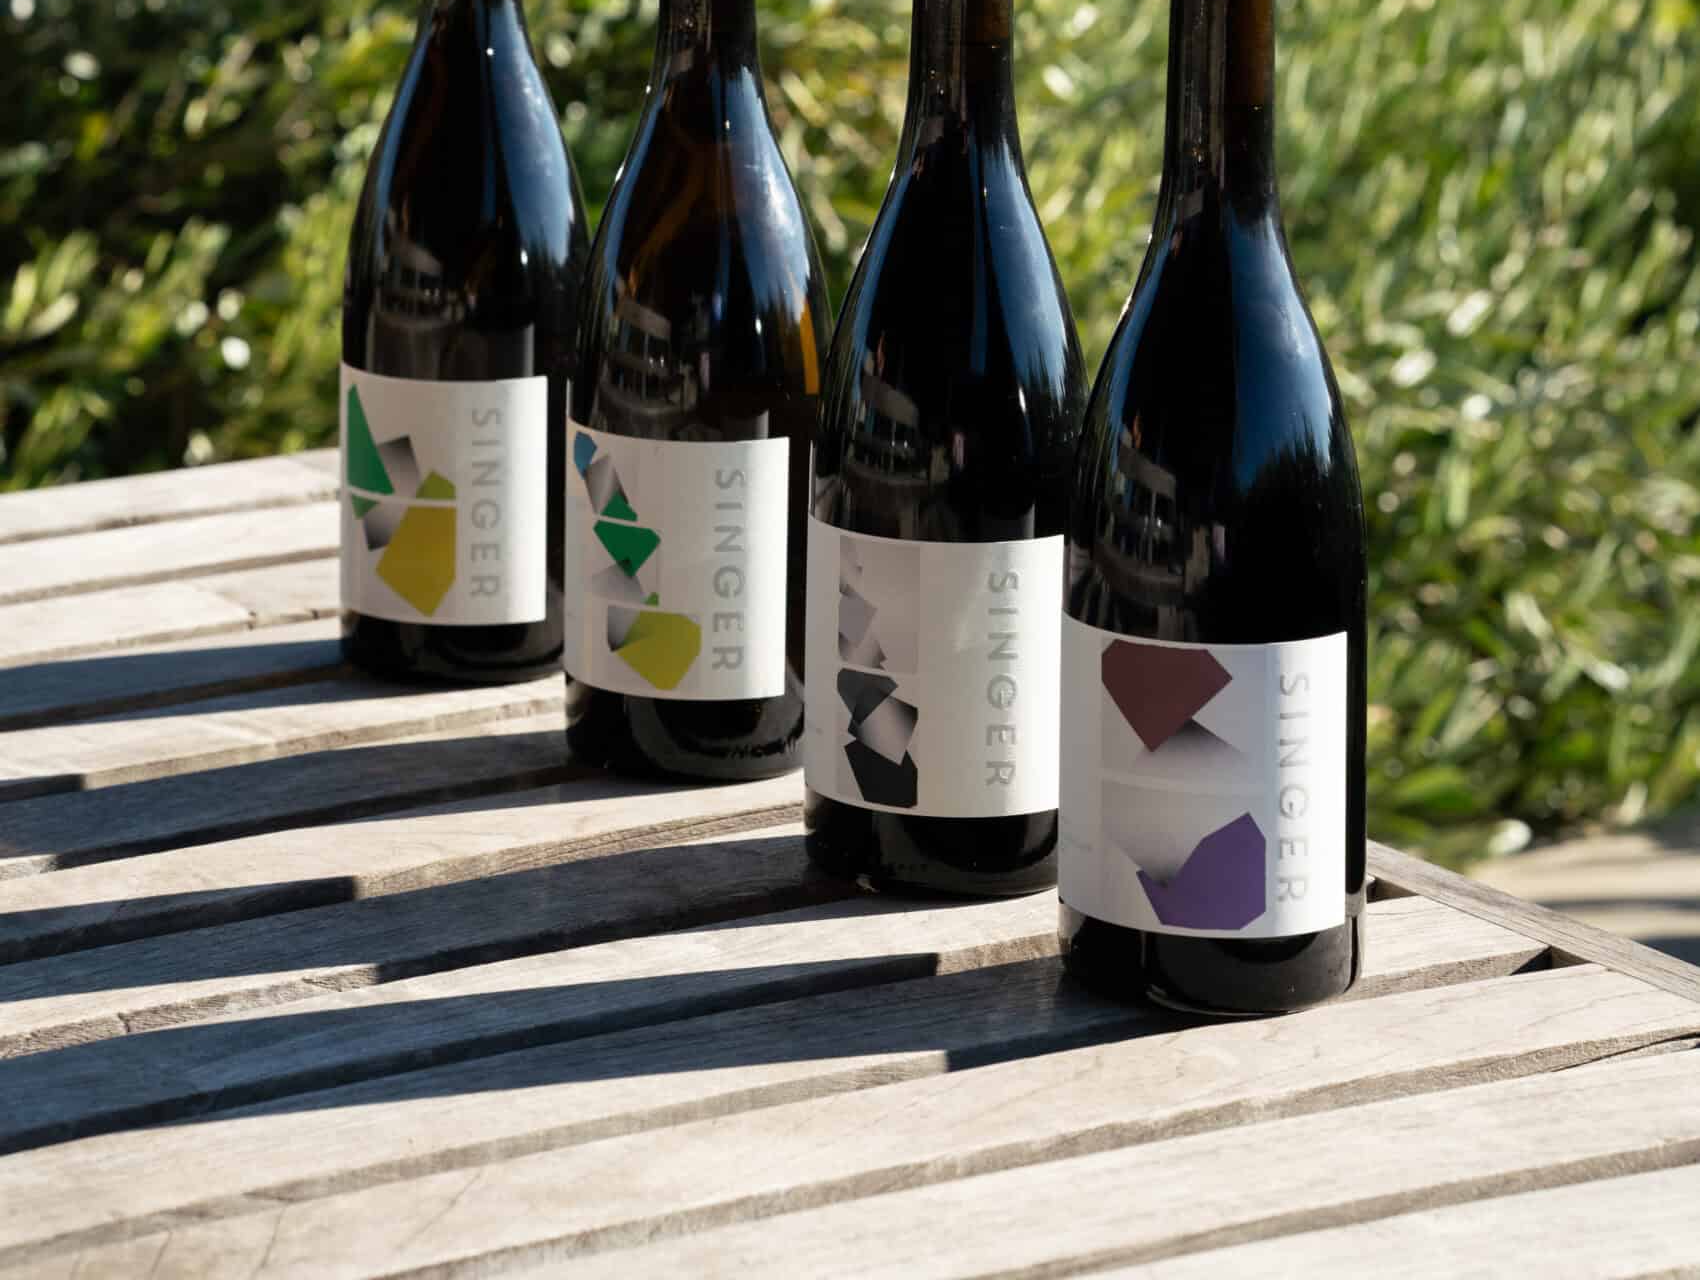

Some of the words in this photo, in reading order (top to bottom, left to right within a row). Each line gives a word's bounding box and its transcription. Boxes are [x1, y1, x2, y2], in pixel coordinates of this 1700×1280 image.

[471, 408, 500, 599] SINGER
[713, 469, 744, 671] SINGER
[986, 571, 1019, 786] SINGER
[1278, 672, 1309, 904] SINGER
